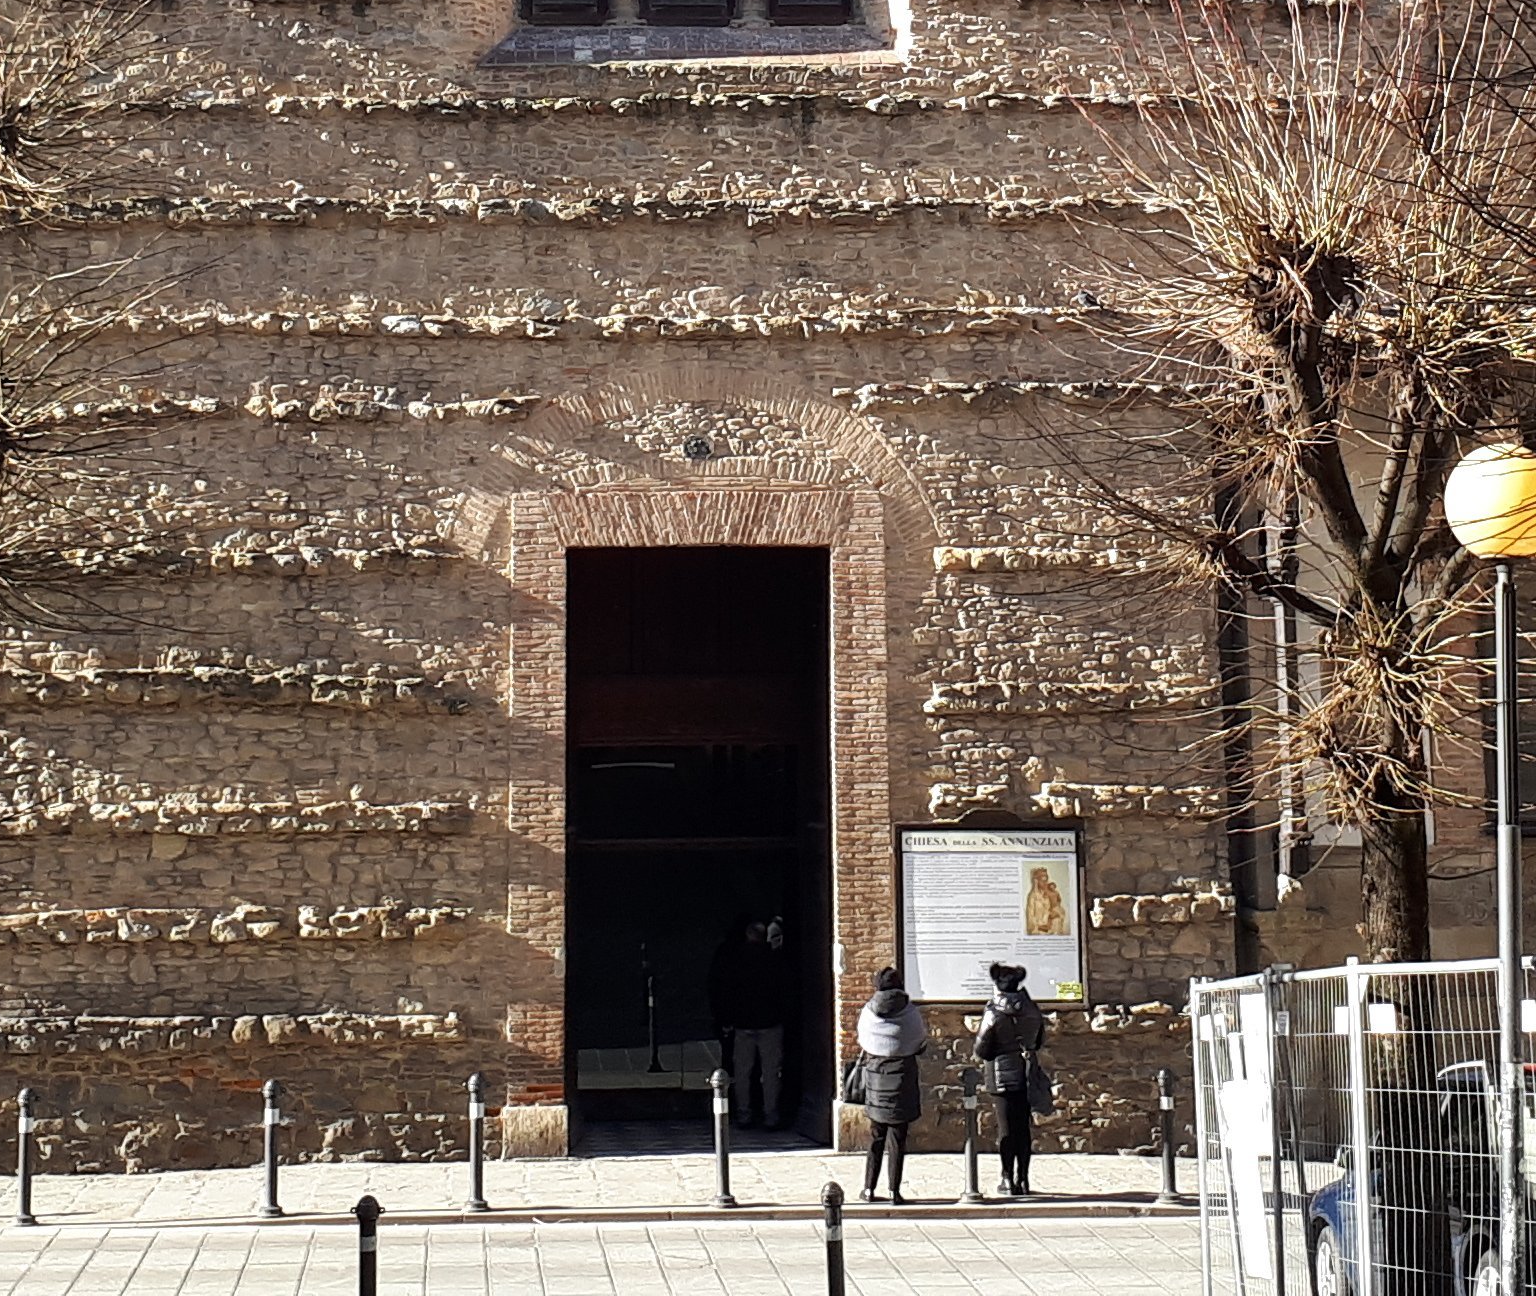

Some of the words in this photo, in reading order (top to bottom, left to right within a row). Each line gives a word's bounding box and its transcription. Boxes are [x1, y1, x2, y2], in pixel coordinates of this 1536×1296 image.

[904, 836, 948, 846] CHIESA
[981, 836, 998, 846] SS.
[1000, 836, 1073, 846] ANNUNZIATA
